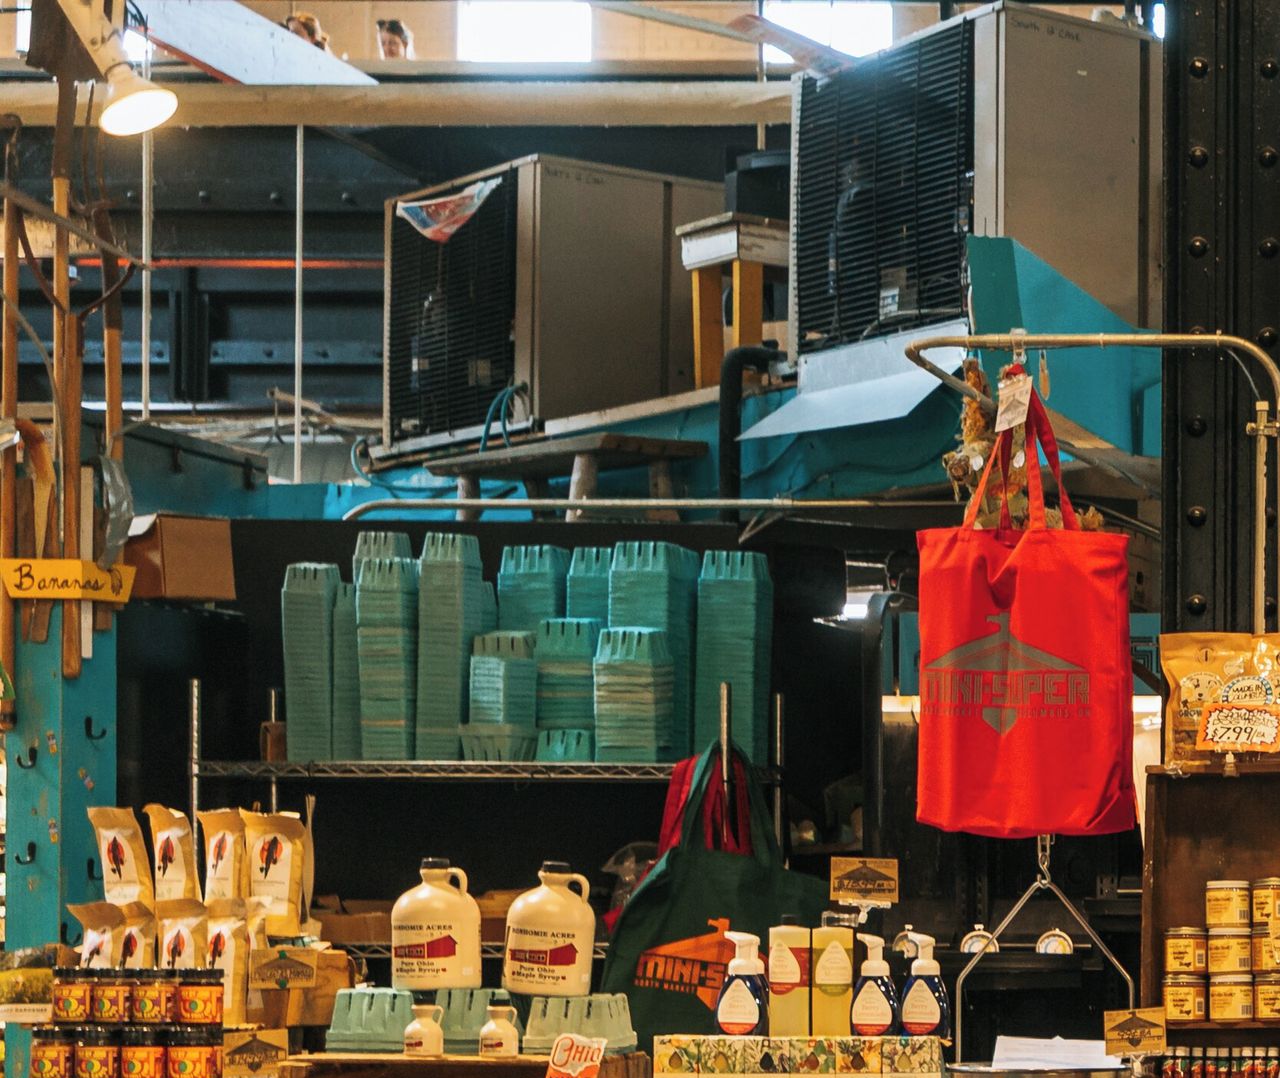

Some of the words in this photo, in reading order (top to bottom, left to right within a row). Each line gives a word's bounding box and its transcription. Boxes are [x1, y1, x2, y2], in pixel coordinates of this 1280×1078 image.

[14, 563, 104, 592] Bananas
[922, 671, 1090, 704] MINI-SUPER
[1233, 685, 1253, 693] MADE
[637, 953, 725, 987] MINI-S
